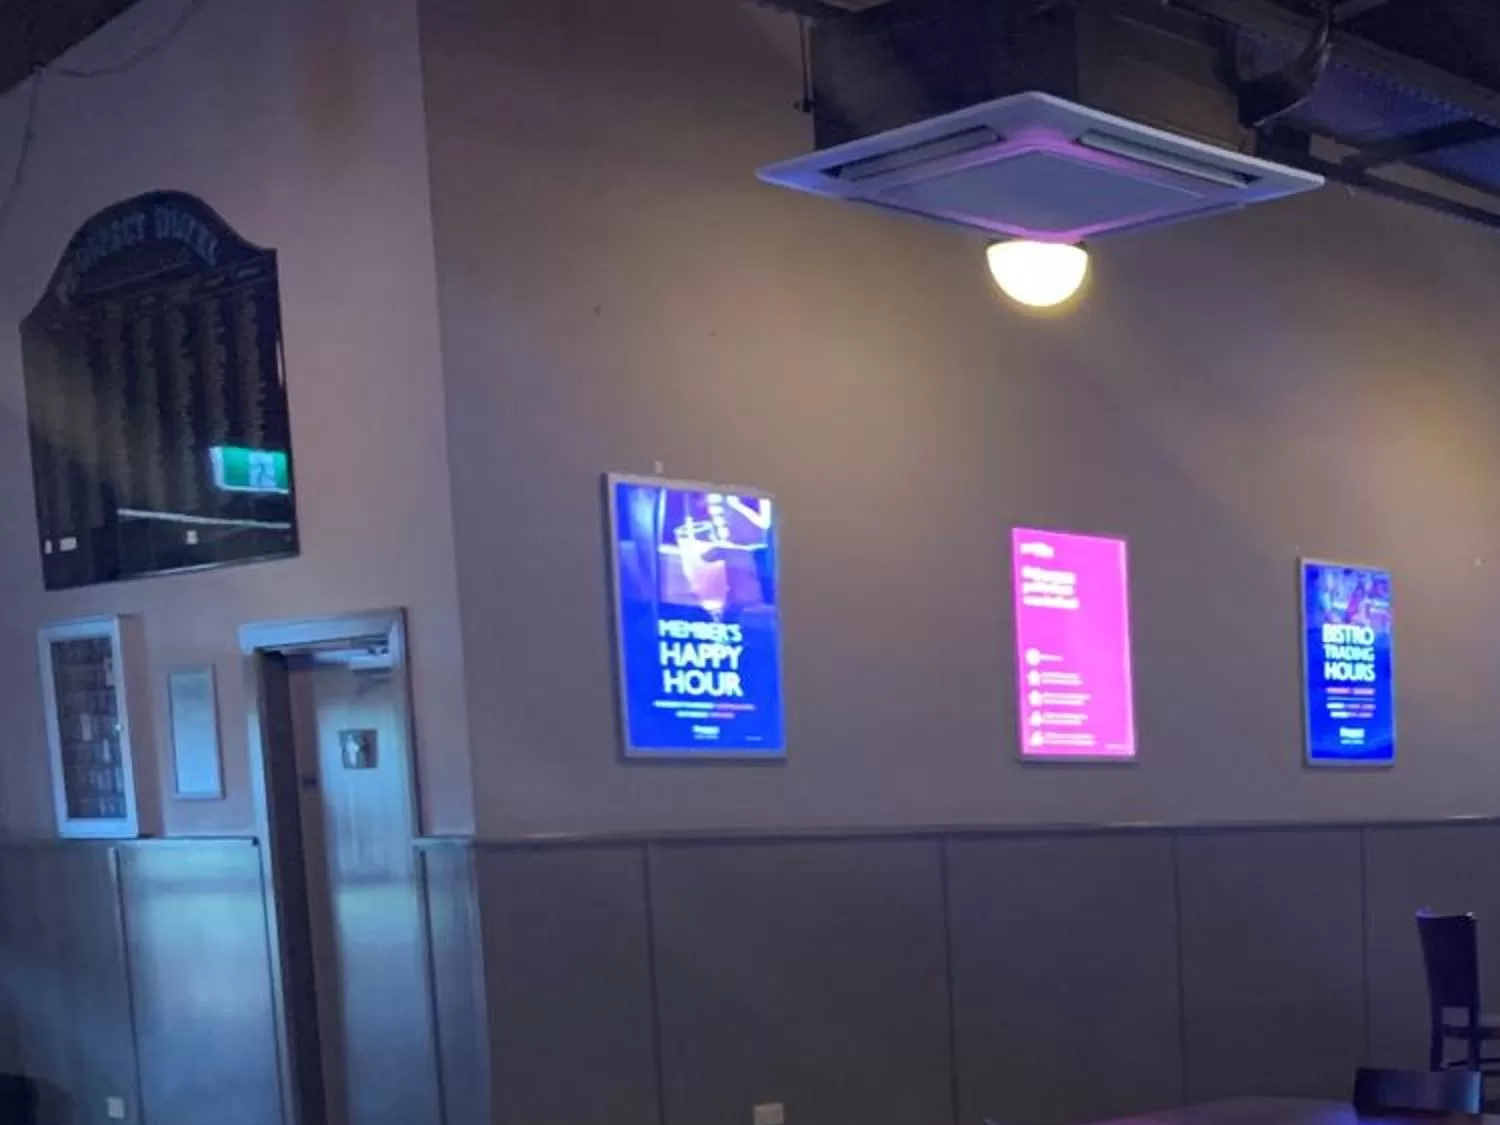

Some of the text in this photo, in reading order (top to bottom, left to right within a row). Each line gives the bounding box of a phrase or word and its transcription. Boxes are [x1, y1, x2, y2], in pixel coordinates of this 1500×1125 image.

[659, 641, 743, 670] HAPPY
[662, 668, 744, 697] HOUR
[1324, 661, 1377, 682] HOURS
